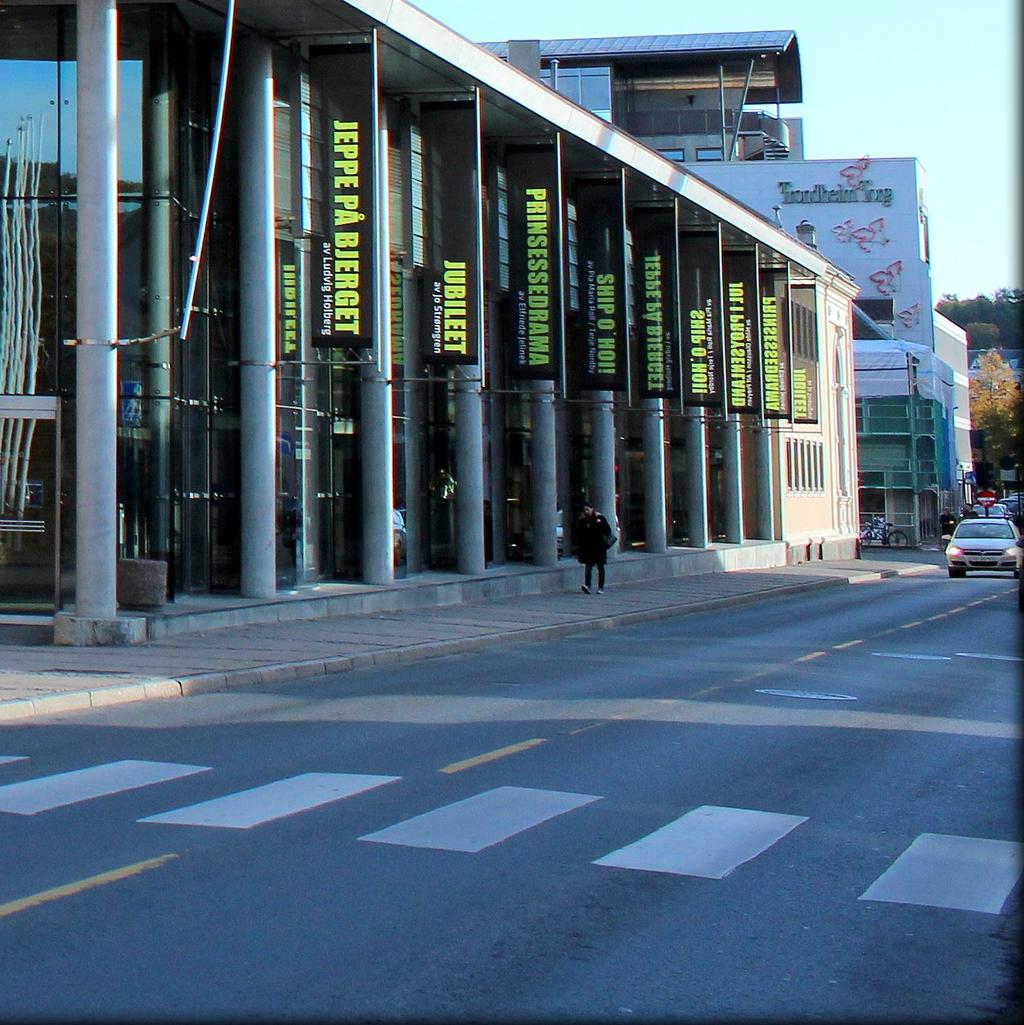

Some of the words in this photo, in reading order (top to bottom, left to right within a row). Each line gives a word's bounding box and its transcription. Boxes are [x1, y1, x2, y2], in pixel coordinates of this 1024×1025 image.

[333, 120, 359, 189] JEPPE
[333, 194, 366, 226] PÅ
[778, 181, 857, 204] Trondheim
[859, 180, 893, 207] Torg
[322, 241, 331, 256] av
[321, 257, 333, 292] Ludvig
[334, 232, 360, 335] BJERGET
[433, 281, 441, 293] av
[526, 188, 550, 366] PRINSESSEDRAMA
[432, 293, 443, 303] Jo
[443, 259, 467, 354] JUBILEET
[597, 273, 615, 314] SHIP
[321, 294, 333, 336] Holberg
[432, 305, 443, 354] Strømgren
[518, 302, 527, 335] Elfriede
[517, 336, 527, 365] Jelinek
